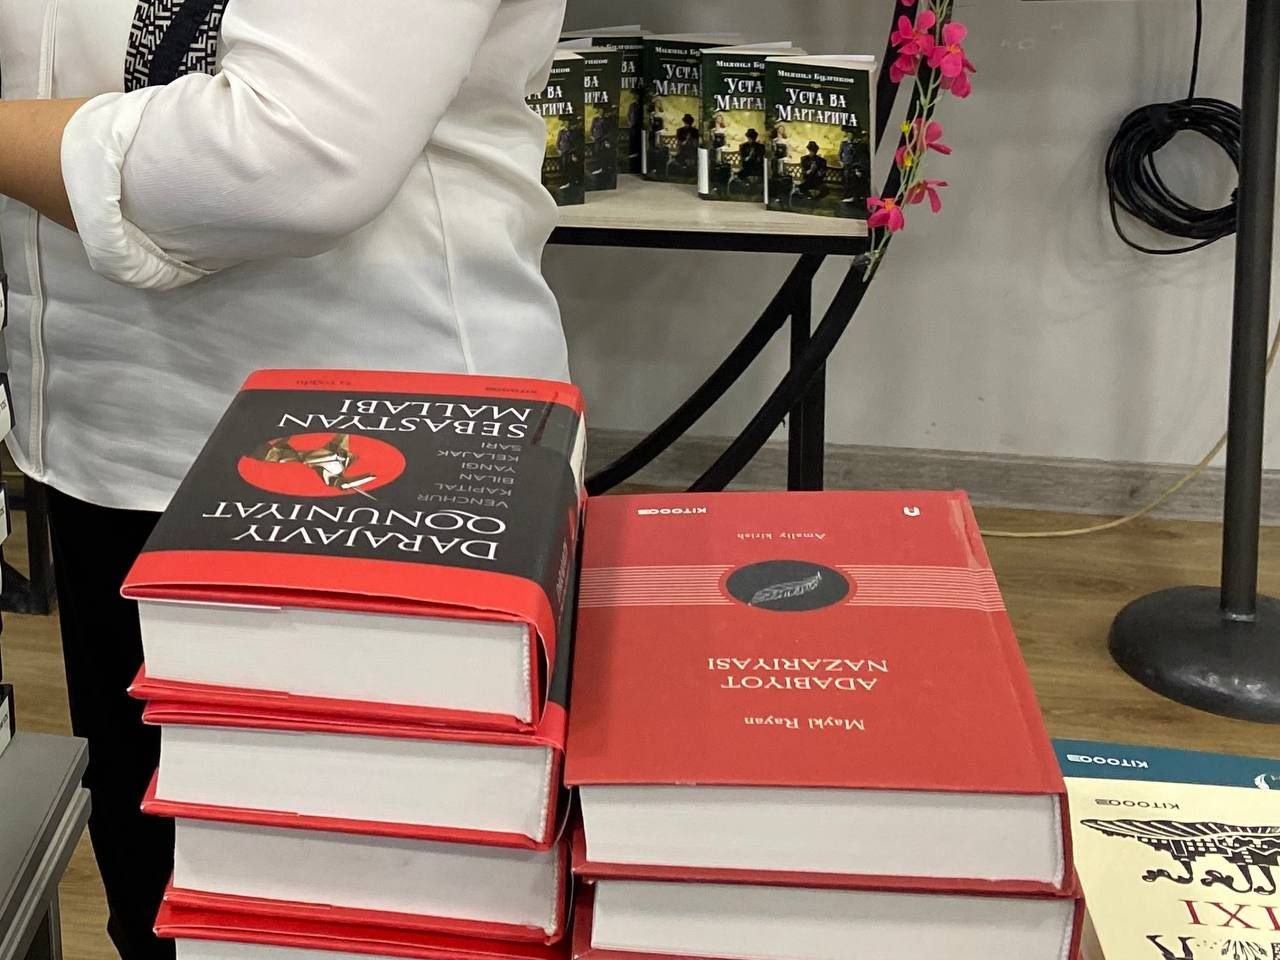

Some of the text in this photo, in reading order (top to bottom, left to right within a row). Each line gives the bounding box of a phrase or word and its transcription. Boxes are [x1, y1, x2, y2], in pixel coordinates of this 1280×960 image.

[339, 398, 532, 422] MALLABI
[276, 412, 529, 439] SEBASTYAN
[480, 441, 522, 453] SARI
[437, 448, 520, 463] KELAJAK
[460, 461, 517, 474] YANGI
[458, 473, 516, 485] BILAN
[433, 482, 512, 497] KAPITAL
[416, 493, 510, 509] VENCHUR
[201, 500, 507, 535] QONUNIYAT
[231, 523, 500, 561] DARAJAVIY
[736, 531, 773, 540] kirish
[707, 656, 889, 672] NAZARIYASI
[720, 675, 879, 691] ADABIYOT
[744, 715, 865, 731] Maykl Rayan
